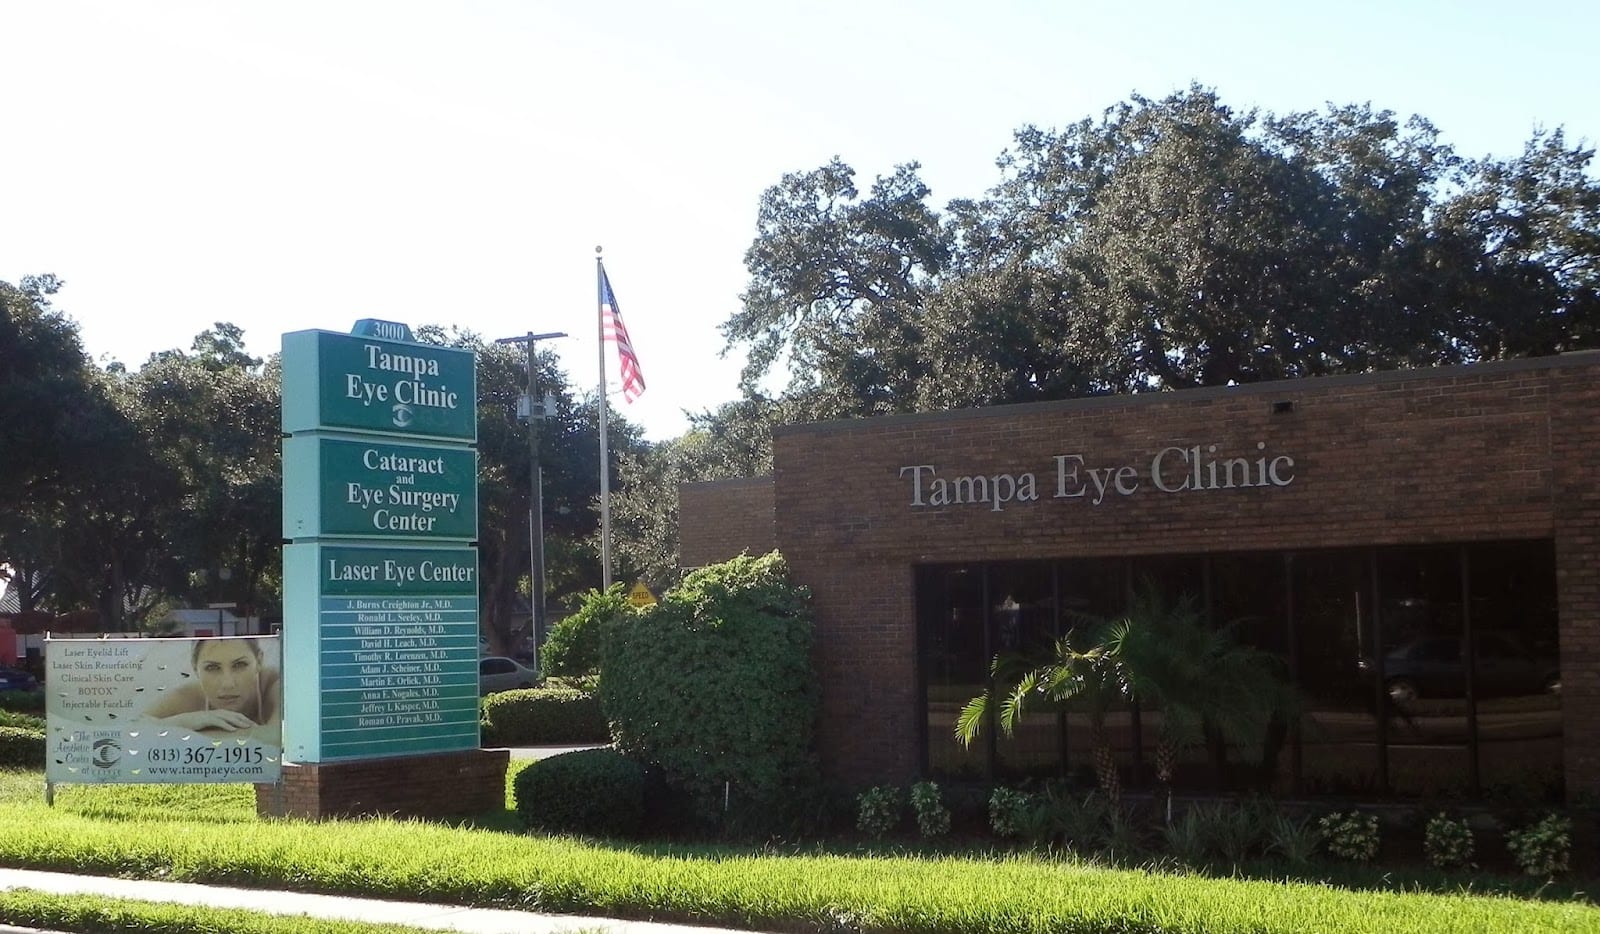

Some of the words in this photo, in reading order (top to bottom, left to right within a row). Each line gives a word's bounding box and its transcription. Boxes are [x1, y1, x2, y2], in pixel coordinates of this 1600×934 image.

[374, 322, 404, 340] 3000
[364, 344, 439, 380] Tampa
[346, 374, 387, 406] Eye
[394, 380, 458, 409] Clinic
[363, 449, 444, 474] Cataract
[396, 474, 414, 485] and
[900, 465, 1039, 511] Tampa
[1053, 454, 1139, 505] Eye
[1151, 442, 1296, 493] Clinic
[347, 483, 383, 509] Eye
[389, 485, 459, 512] Surgery
[374, 509, 436, 531] Center
[329, 559, 379, 581] Laser
[384, 560, 415, 587] Eye
[420, 561, 474, 582] Center
[382, 600, 419, 610] Creighton
[435, 600, 452, 608] M.D.
[358, 614, 385, 622] Ronald
[388, 614, 395, 622] L.
[398, 614, 422, 623] Seeley,
[425, 613, 442, 621] M.D.
[354, 627, 381, 635] William
[429, 626, 446, 634] M.D.
[361, 640, 381, 648] David
[384, 640, 392, 648] H.
[65, 648, 84, 657] Laser
[88, 648, 112, 658] Eyelid
[115, 648, 129, 656] Lift
[354, 653, 382, 662] Timothy
[385, 652, 392, 660] R.
[430, 651, 448, 659] M.D.
[53, 661, 72, 669] Laser
[75, 661, 93, 669] Skin
[96, 661, 143, 670] Resurfacing
[360, 666, 380, 674] Adam
[382, 665, 389, 673] J.
[61, 674, 91, 682] Clinical
[94, 674, 112, 682] Skin
[114, 674, 134, 682] Care
[360, 678, 385, 686] Martin
[423, 676, 441, 684] M.D.
[361, 692, 380, 700] Anna
[422, 688, 439, 696] M.D.
[62, 700, 100, 710] Injectable
[104, 700, 134, 708] FaceLift
[361, 703, 384, 713] Jeffrey
[423, 701, 439, 709] M.D.
[359, 718, 384, 726] Roman
[386, 716, 395, 724] O.
[425, 713, 442, 721] M.D.
[148, 749, 180, 763] (813)
[184, 747, 263, 764] 367-1915
[148, 766, 263, 778] www.tampaeye.com
